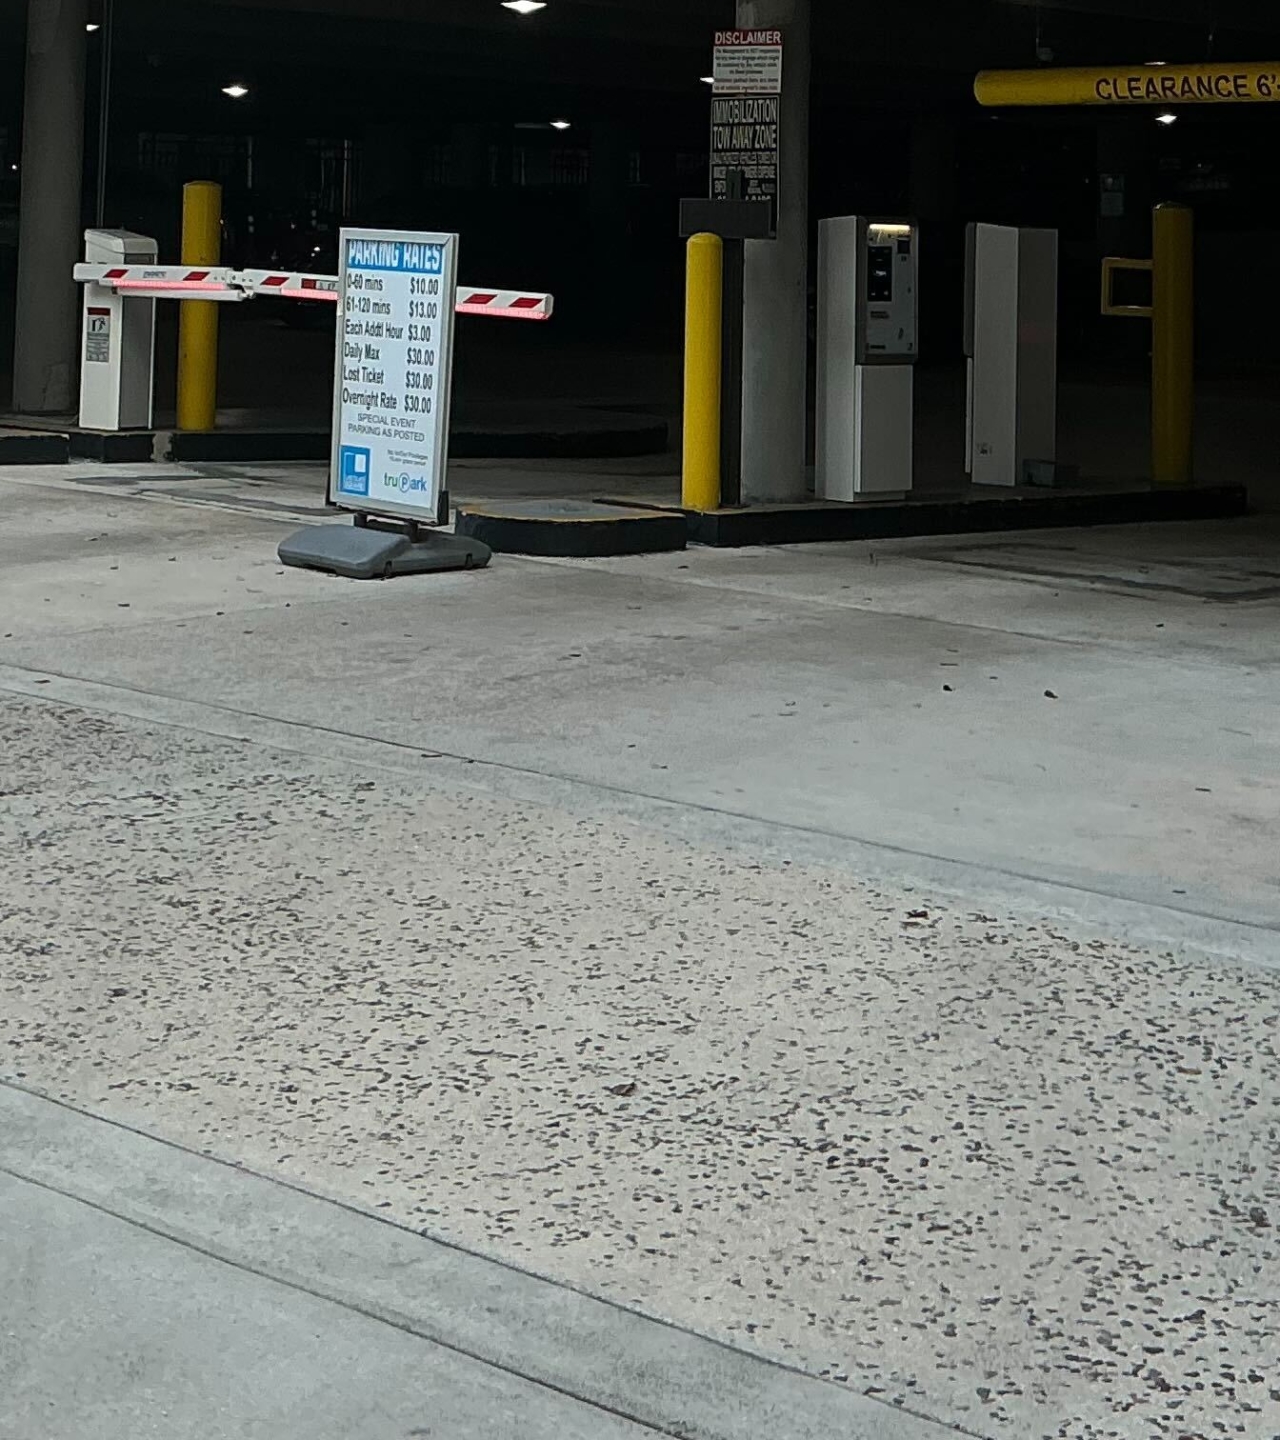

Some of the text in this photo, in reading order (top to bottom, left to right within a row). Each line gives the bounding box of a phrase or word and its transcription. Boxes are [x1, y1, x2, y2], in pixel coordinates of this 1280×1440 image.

[714, 30, 782, 45] DISCLAIMER
[1094, 73, 1250, 102] CLEARANCE
[712, 124, 777, 150] TOW AWAY ZONE
[348, 240, 441, 270] PARKING RATES
[346, 273, 363, 290] 0-60
[364, 275, 383, 292] mins
[409, 276, 439, 296] $10.00
[346, 296, 437, 319] 61-120 mins $13.00
[345, 319, 363, 336] Each
[385, 322, 404, 340] Hour
[408, 324, 431, 342] $3.00
[344, 342, 435, 366] Daily Max $30.00
[343, 366, 433, 390] Lost Ticket $30.00
[342, 388, 432, 414] Overnight Rate $30.00
[357, 412, 416, 428] SPECIAL EVENT
[347, 423, 425, 443] PARKING AS POSTED
